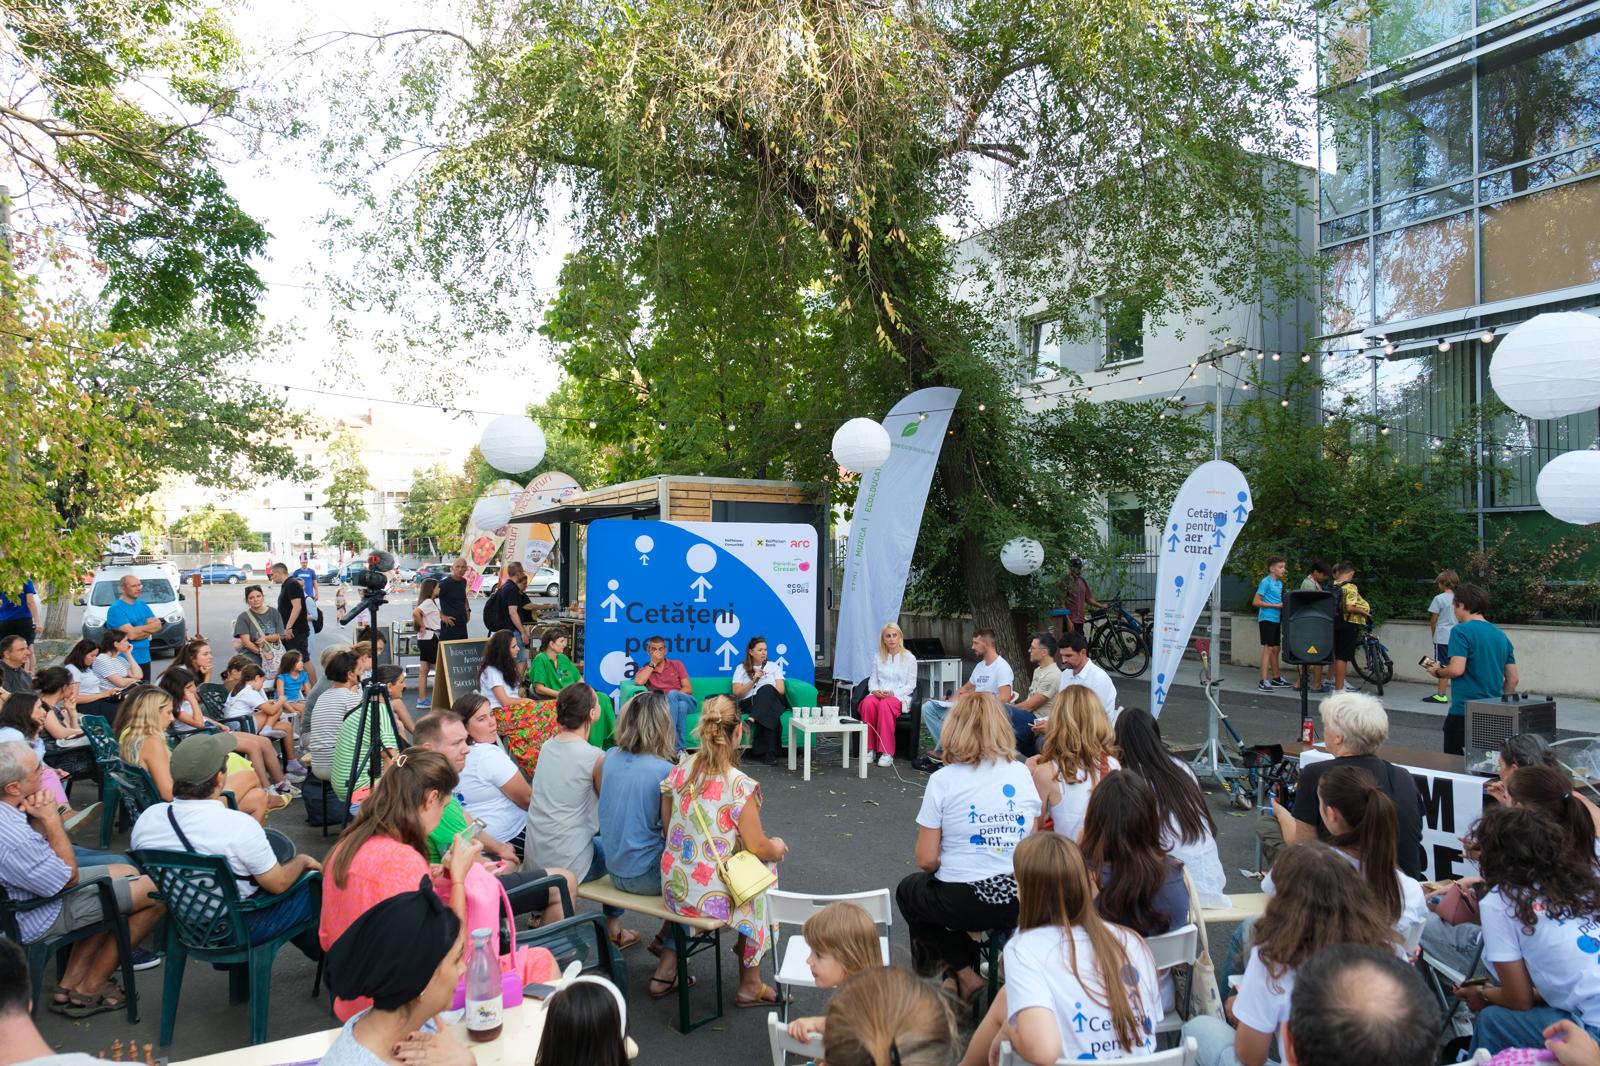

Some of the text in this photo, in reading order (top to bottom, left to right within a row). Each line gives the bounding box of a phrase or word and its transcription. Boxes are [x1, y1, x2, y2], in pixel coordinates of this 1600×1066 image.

[1185, 522, 1217, 532] pentru
[855, 527, 867, 557] MUZICA
[1184, 533, 1204, 543] aer
[790, 540, 810, 549] arc
[1184, 544, 1214, 555] curat
[625, 601, 735, 631] Cetățeni
[979, 826, 1017, 836] pentru
